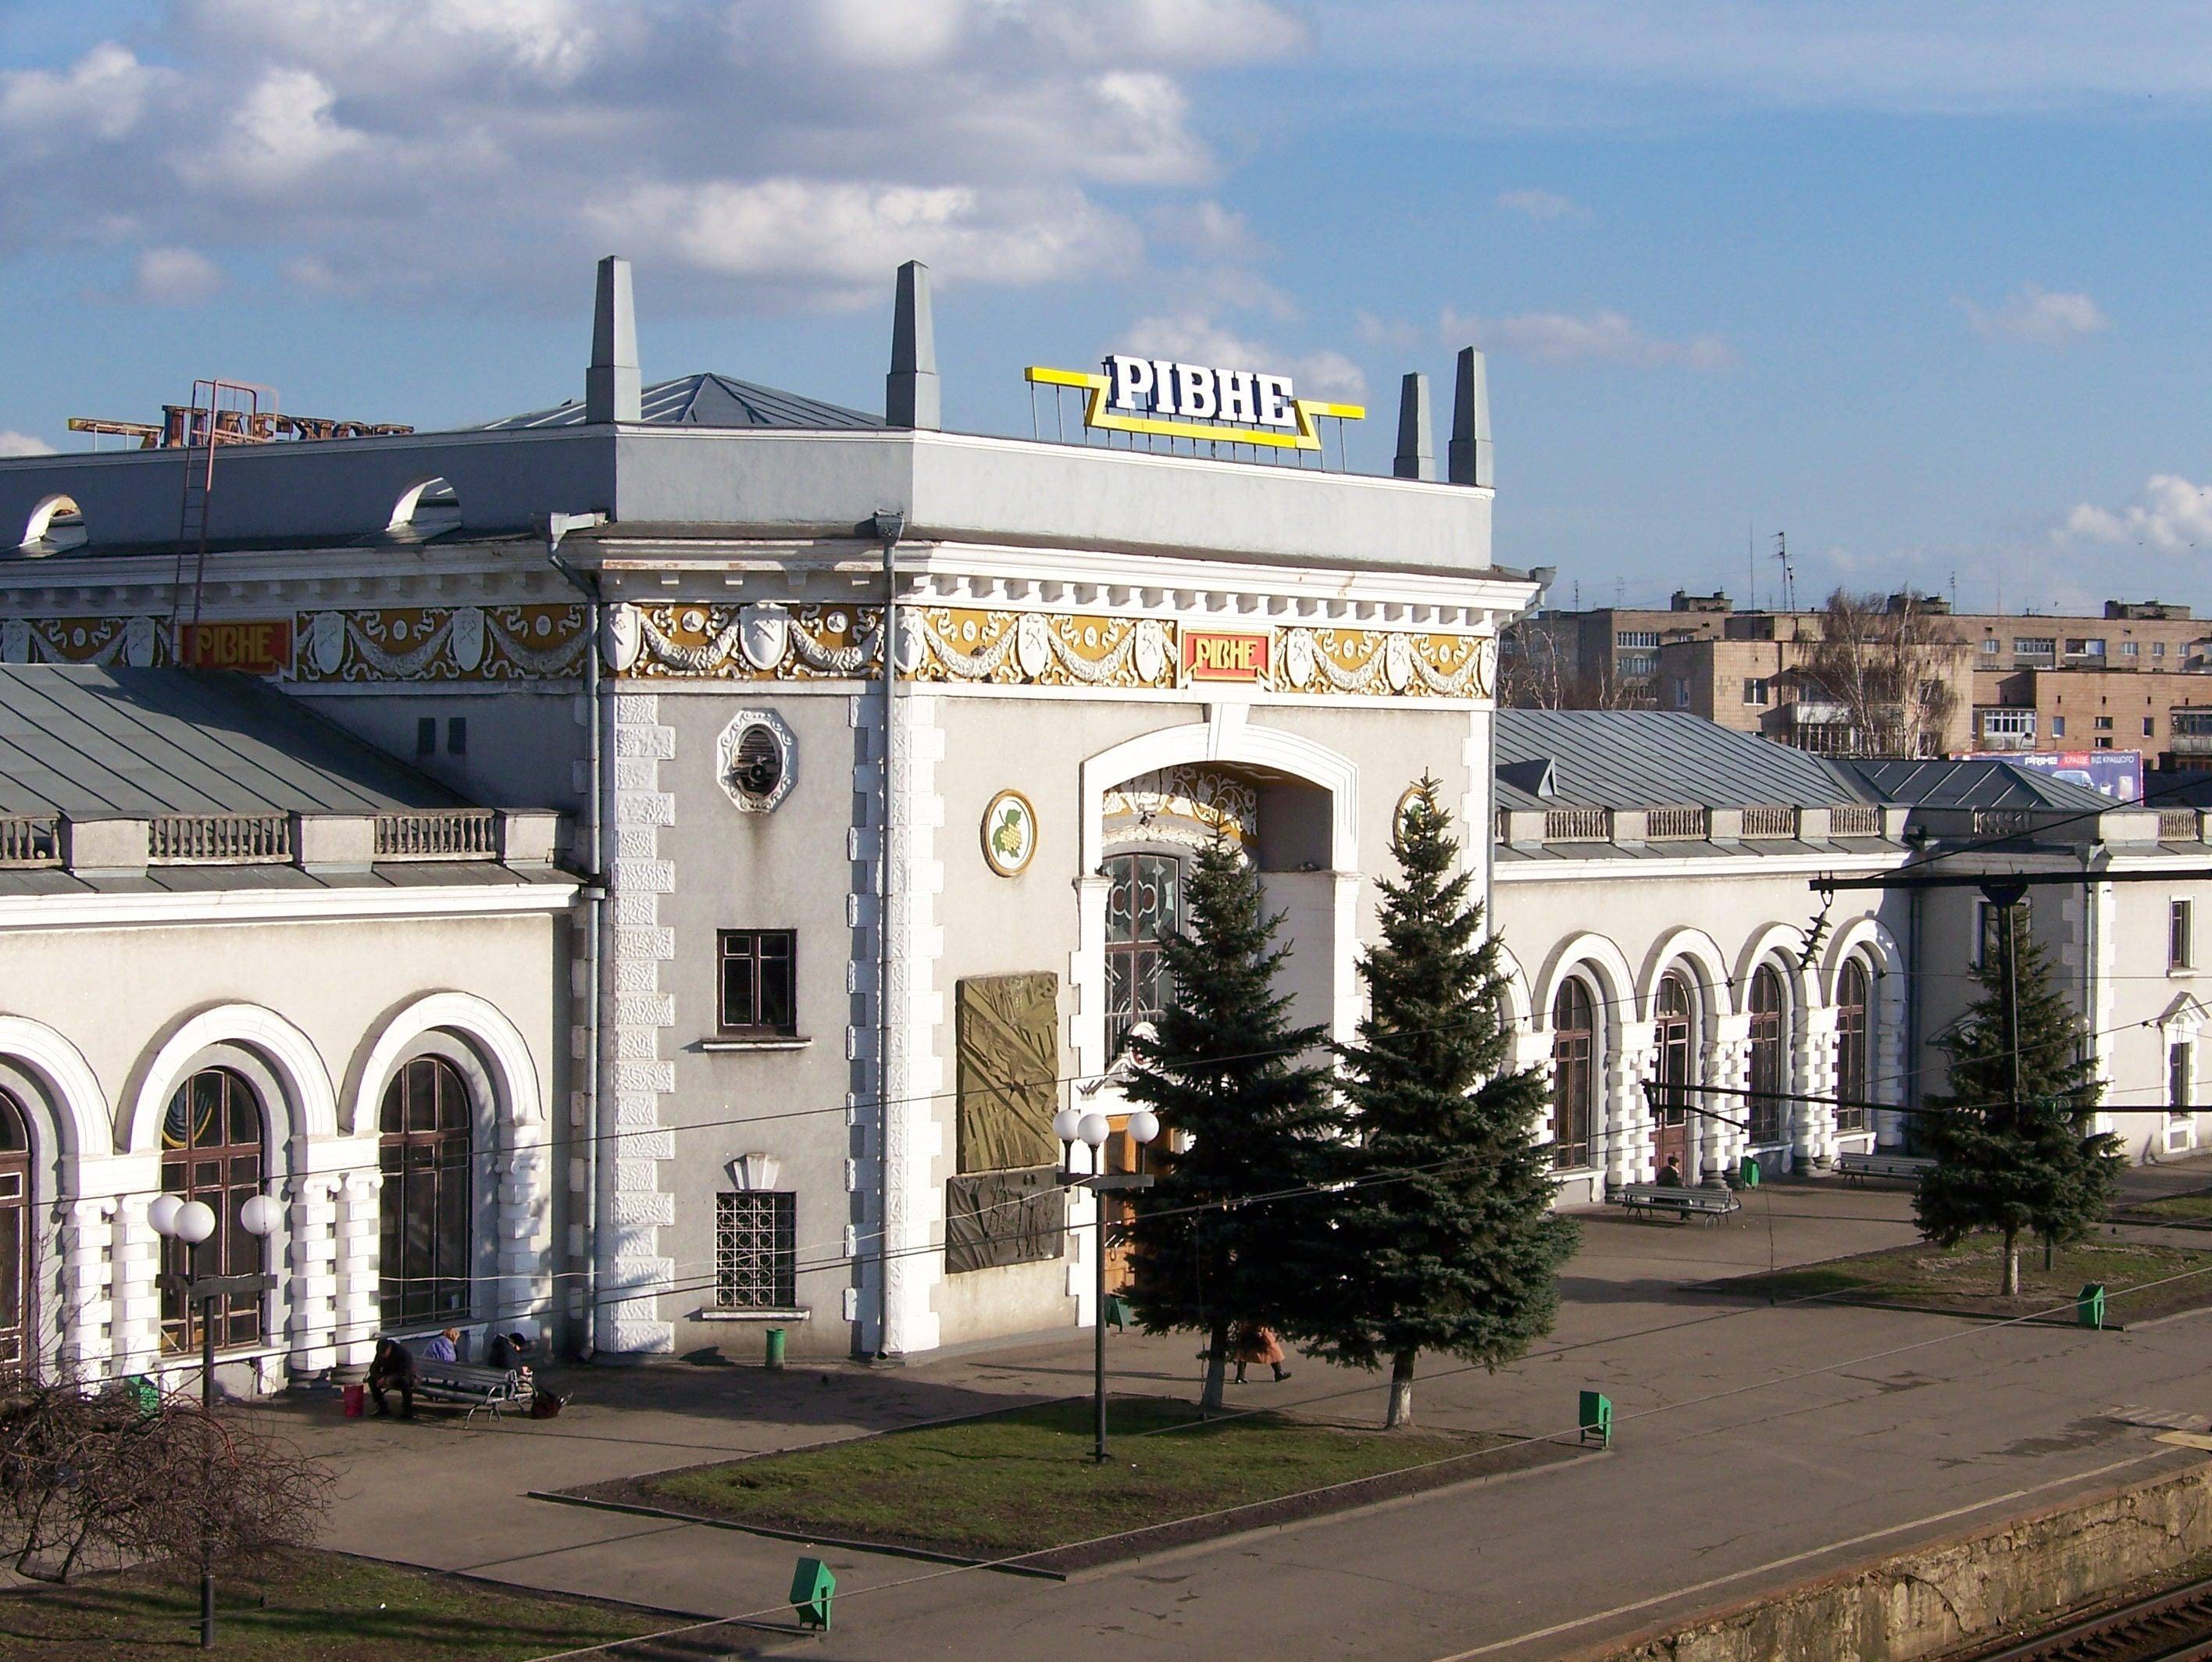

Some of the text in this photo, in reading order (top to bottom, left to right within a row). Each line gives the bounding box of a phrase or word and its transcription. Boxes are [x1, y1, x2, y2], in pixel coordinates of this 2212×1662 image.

[1106, 355, 1297, 427] РІВНЕ
[196, 626, 274, 664] РІВНЕ
[1196, 637, 1258, 669] РІВНЕ
[2025, 755, 2058, 766] PRIME
